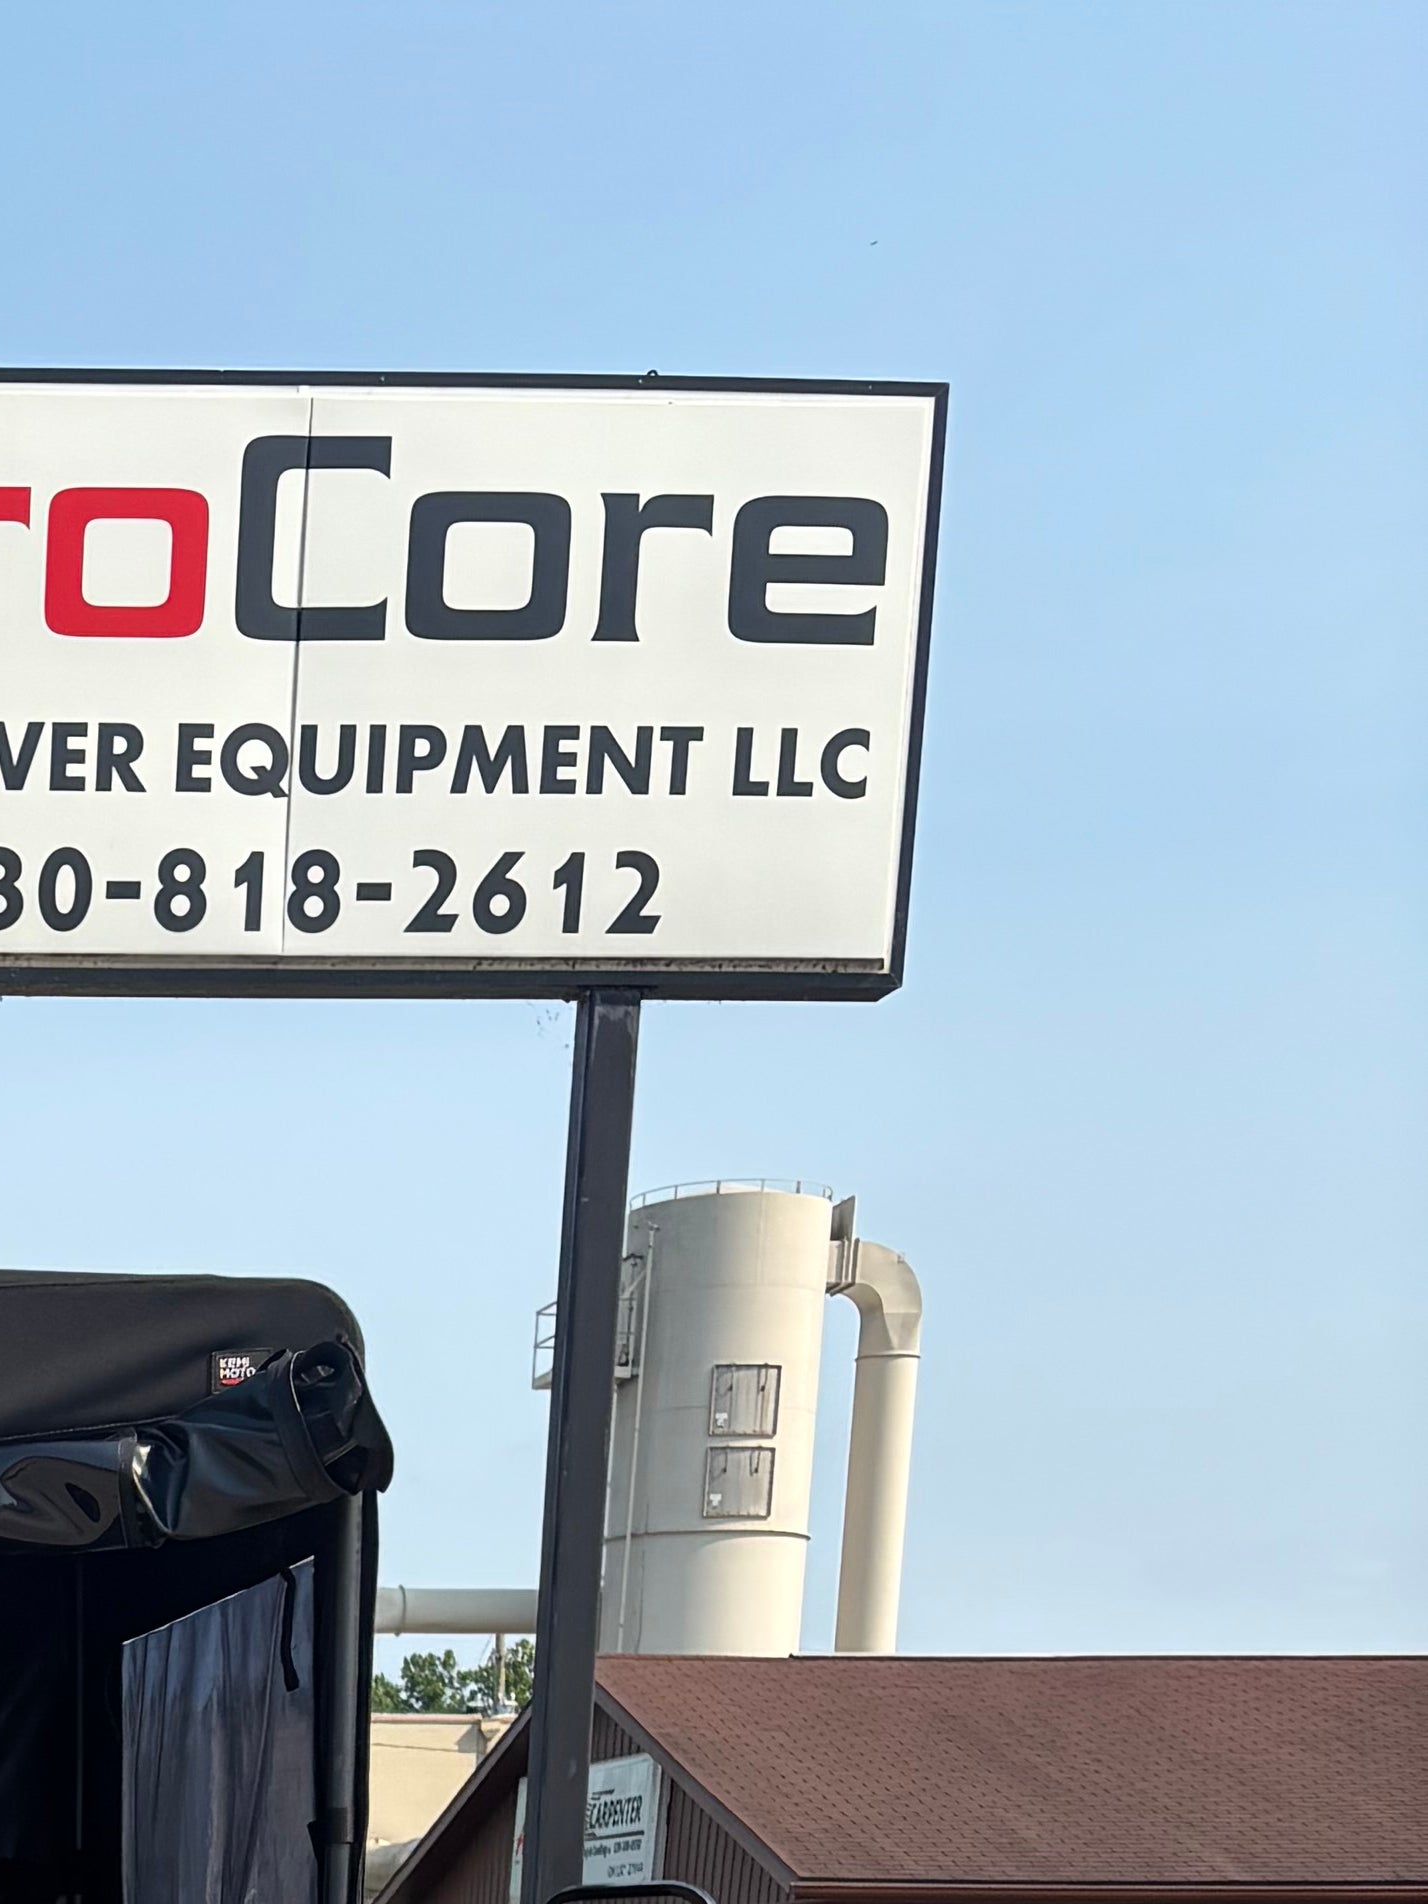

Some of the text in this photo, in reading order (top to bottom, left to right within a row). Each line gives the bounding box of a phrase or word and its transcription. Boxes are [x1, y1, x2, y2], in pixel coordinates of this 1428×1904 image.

[176, 723, 704, 800] EQUIPMENT
[733, 728, 870, 799] LLC
[219, 1367, 257, 1379] MOTO
[589, 1796, 642, 1829] CARPENTER
